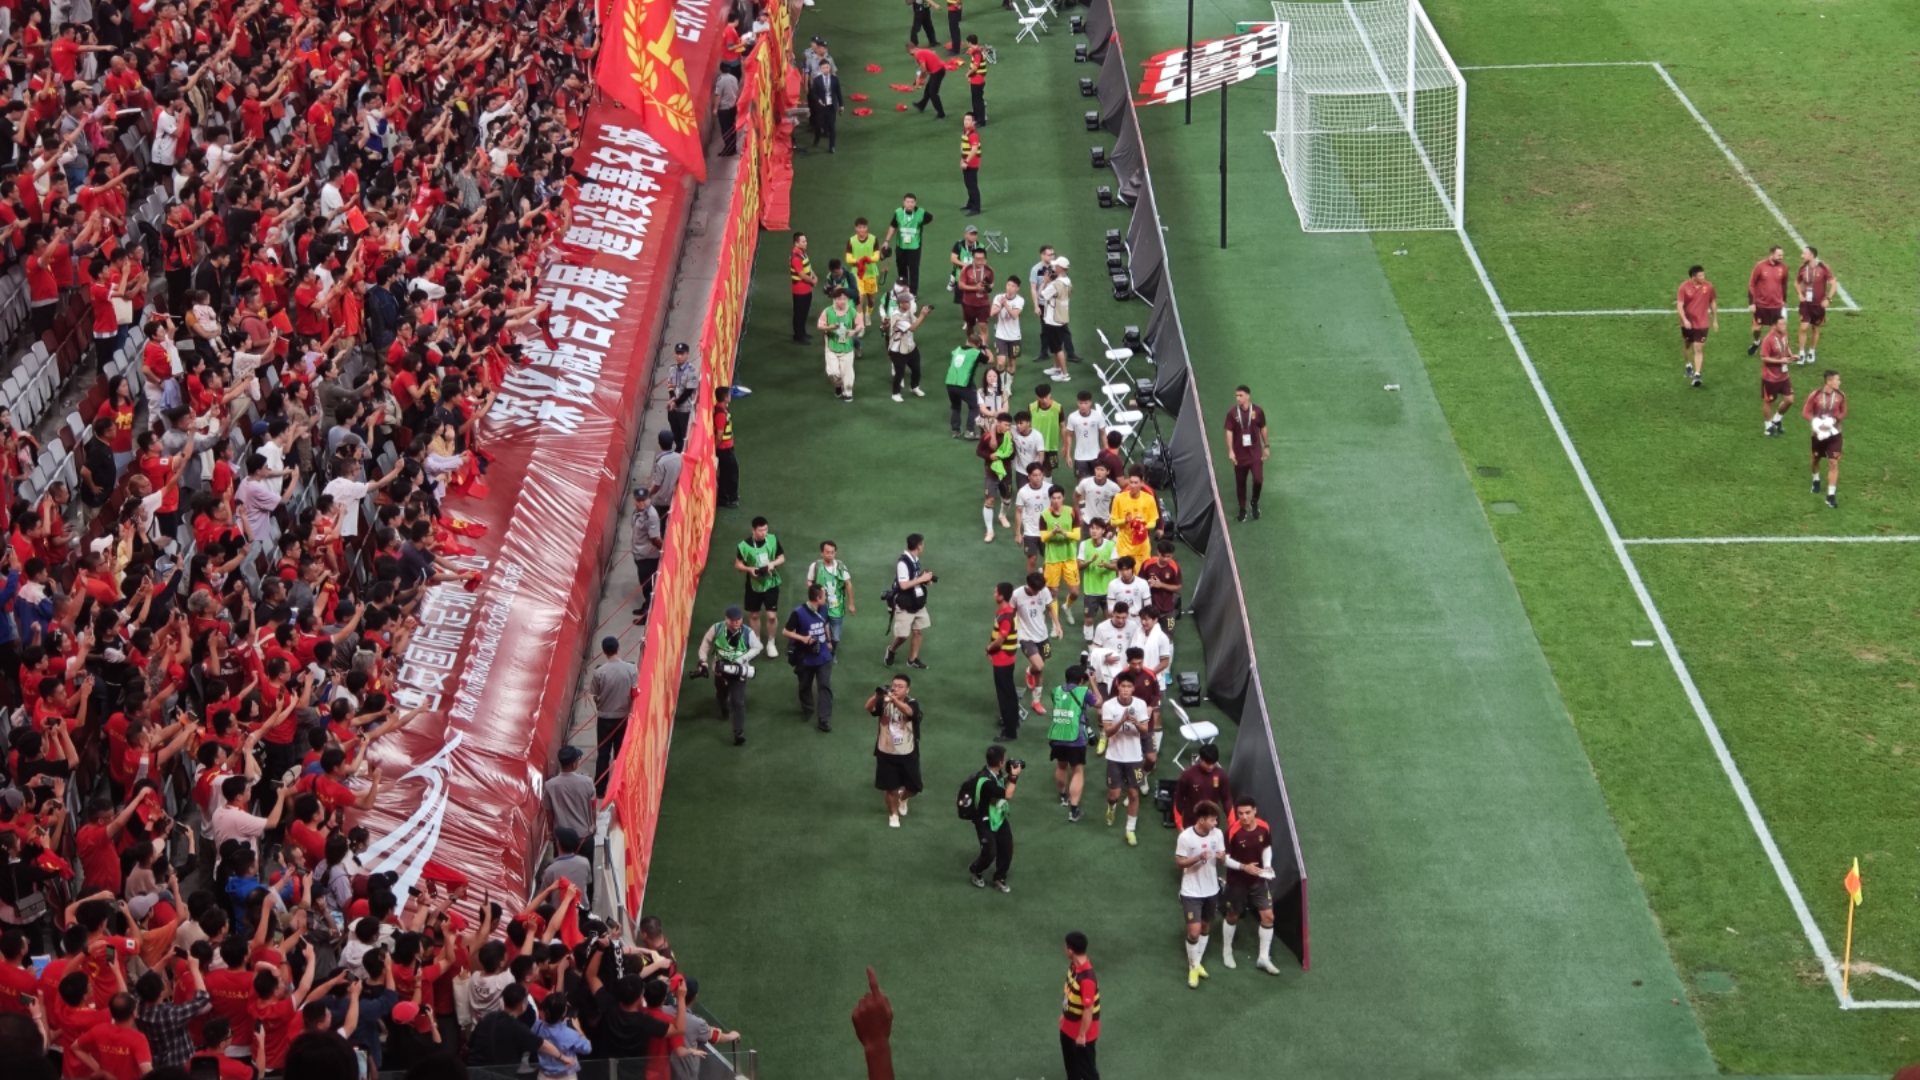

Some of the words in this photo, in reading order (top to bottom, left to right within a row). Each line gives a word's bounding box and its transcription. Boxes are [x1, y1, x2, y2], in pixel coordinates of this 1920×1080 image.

[487, 263, 633, 434] 深化融合发展
[562, 123, 669, 261] 建设赛事名城
[392, 555, 490, 712] 西安国际足球心
[465, 633, 502, 697] INTERNATIONAL
[486, 593, 516, 633] FOOTBALL
[501, 562, 523, 592] CENTER
